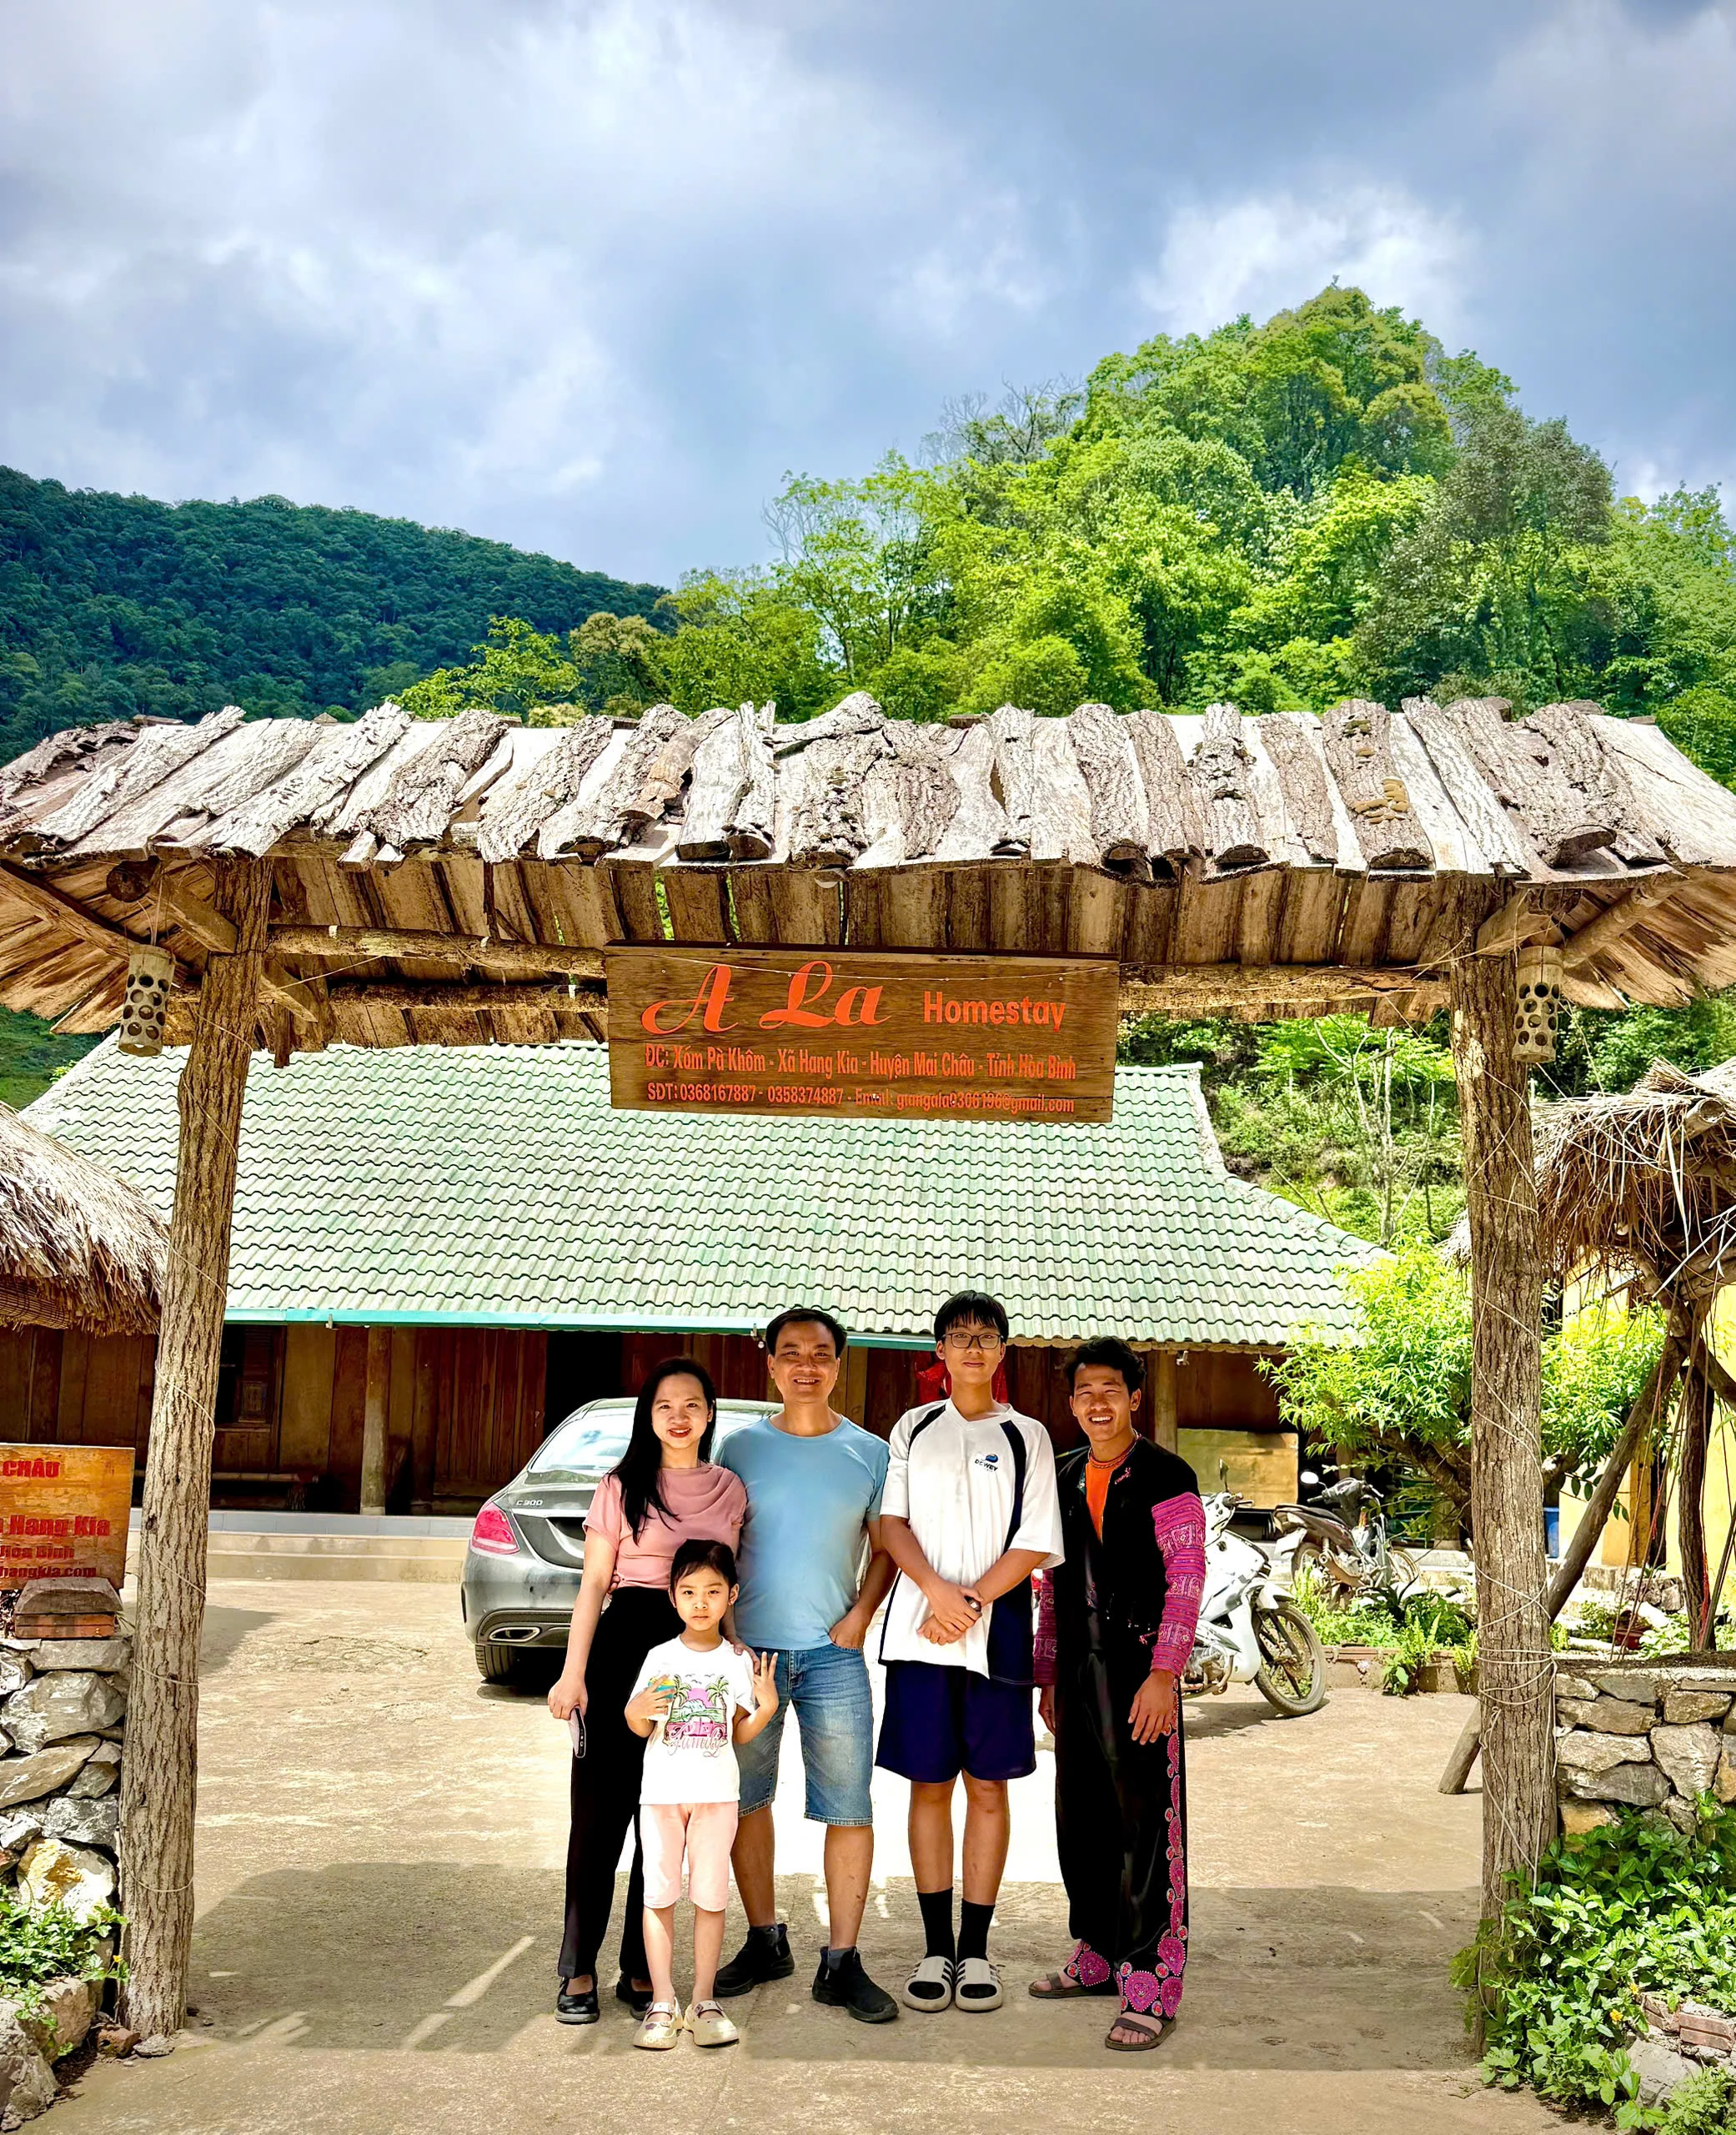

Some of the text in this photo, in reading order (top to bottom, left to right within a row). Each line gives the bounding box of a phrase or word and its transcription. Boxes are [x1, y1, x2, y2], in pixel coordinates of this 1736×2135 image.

[641, 960, 1066, 1034] A La Homestay
[645, 1043, 669, 1068] ĐC:
[672, 1044, 704, 1070] Xóm
[707, 1046, 725, 1071] Pà
[727, 1047, 766, 1072] Khôm
[777, 1048, 796, 1073] Xã
[799, 1048, 833, 1081] Hang
[836, 1050, 860, 1075] Kia
[870, 1051, 910, 1081] Huyện
[913, 1051, 938, 1077] Mai
[941, 1052, 976, 1077] Châu
[1018, 1053, 1045, 1078] Hòa
[1047, 1054, 1076, 1080] Bình
[767, 1085, 844, 1105] 0358374887
[3, 1458, 60, 1478] CHÂU
[9, 1515, 69, 1536] Hang
[74, 1515, 111, 1536] Kia
